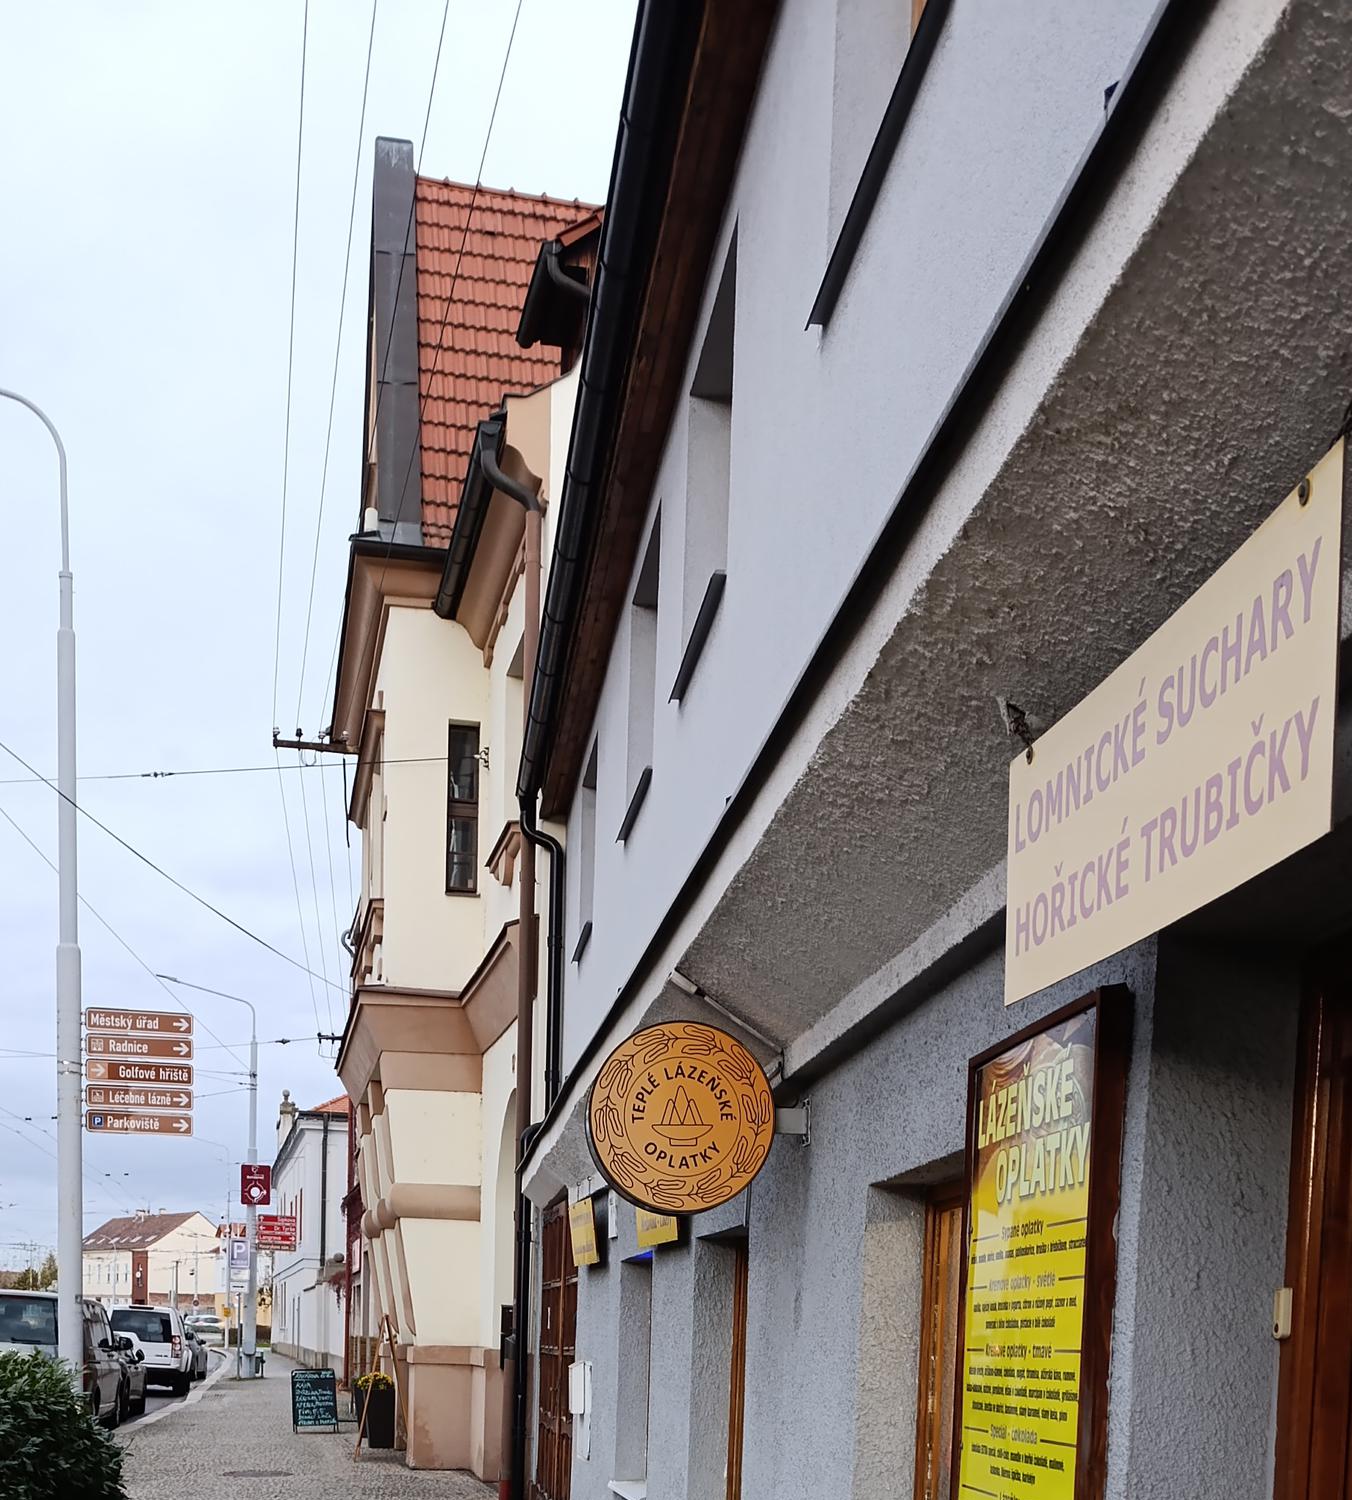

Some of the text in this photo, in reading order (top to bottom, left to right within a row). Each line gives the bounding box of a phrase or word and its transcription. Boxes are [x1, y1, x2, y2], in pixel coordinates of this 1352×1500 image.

[1015, 536, 1322, 855] LOMNICKÉ SUCHARY
[1015, 696, 1320, 957] HOŘICKÉ TRUBIČKY
[90, 1013, 159, 1030] Městský úřad
[109, 1039, 148, 1053] Radnice
[119, 1065, 189, 1081] Golfové hřiště
[109, 1090, 171, 1105] Léčebné lázně
[632, 1061, 736, 1123] TEPLÉ LÁZEŇSKÉ
[978, 1042, 1074, 1149] LÁZEŇSKÉ
[107, 1115, 159, 1130] Parkoviště
[644, 1141, 721, 1169] OPLATKY
[996, 1121, 1090, 1204] OPLATKY
[1021, 1219, 1044, 1238] oplatky
[233, 1243, 246, 1258] P
[1007, 1344, 1027, 1360] oplatky
